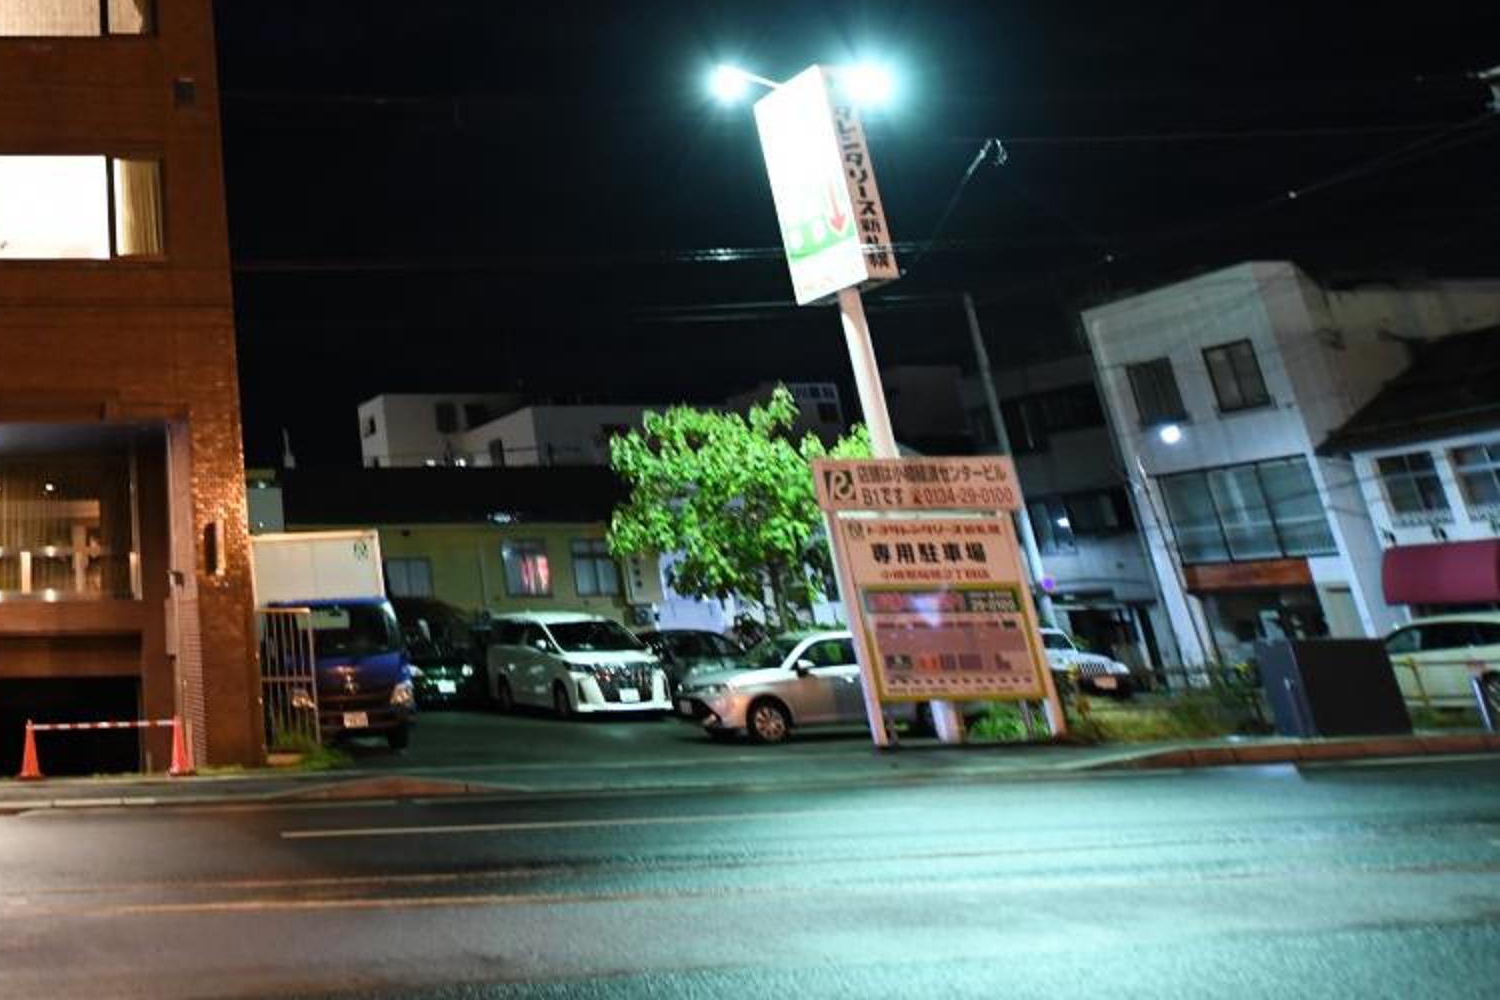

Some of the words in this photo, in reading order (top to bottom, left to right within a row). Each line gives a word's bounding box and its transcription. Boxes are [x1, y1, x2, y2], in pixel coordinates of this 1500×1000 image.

[870, 542, 987, 564] 専用駐車場
